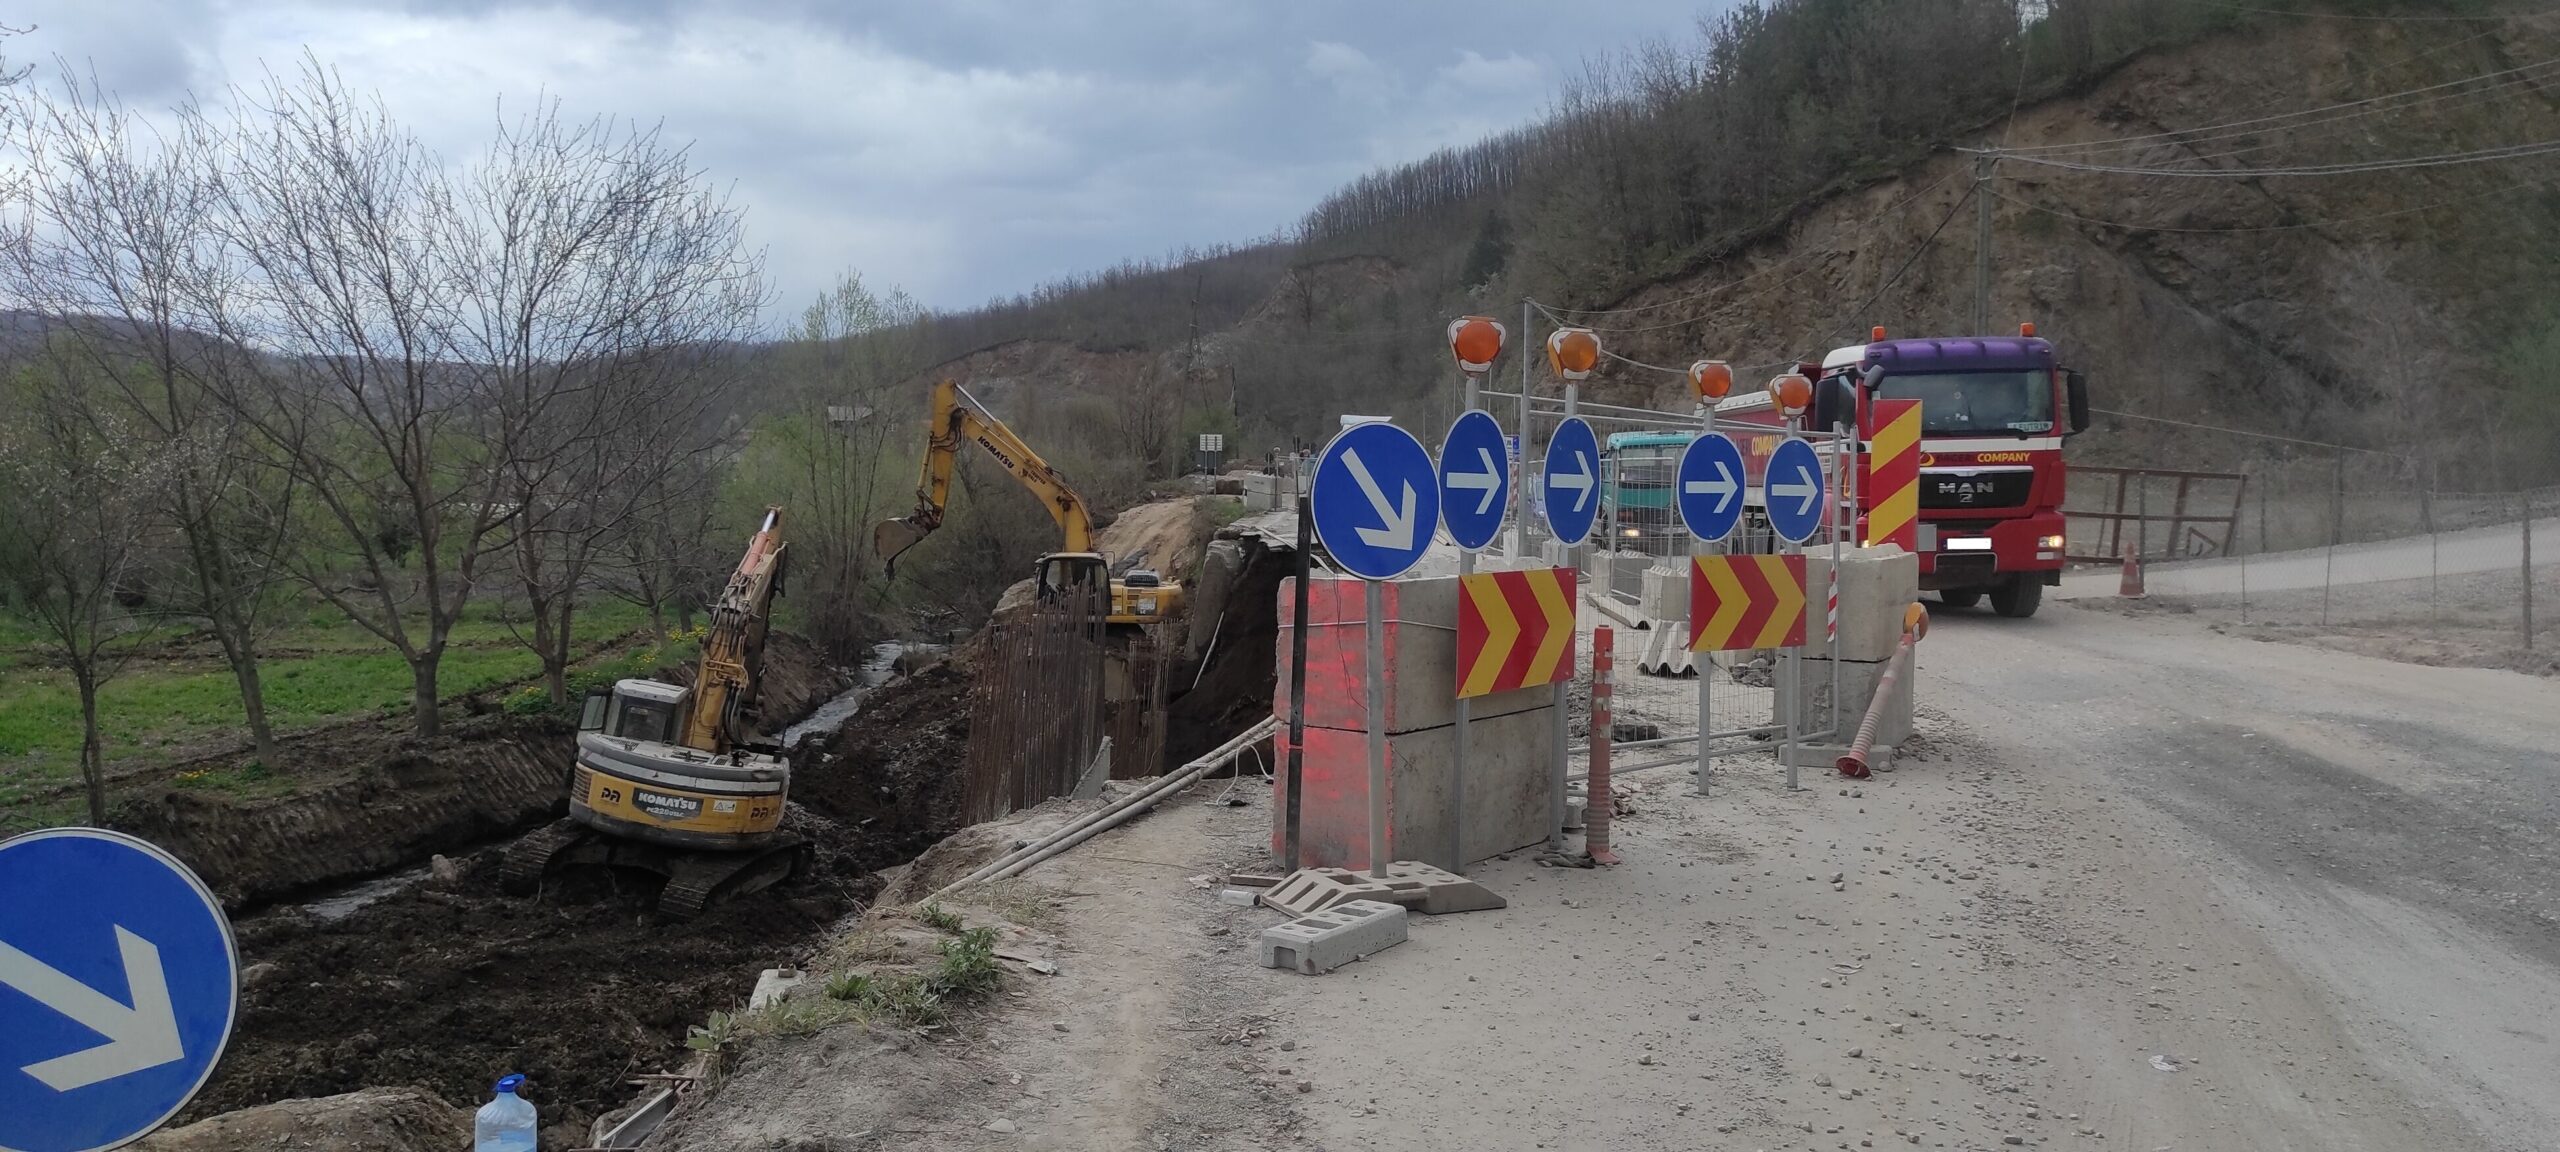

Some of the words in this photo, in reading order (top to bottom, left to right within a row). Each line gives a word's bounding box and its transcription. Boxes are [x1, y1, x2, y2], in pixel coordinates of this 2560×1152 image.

[977, 436, 1015, 469] KOMATSU
[1977, 452, 2031, 463] COMPANY
[1939, 482, 1994, 494] MAN
[638, 792, 698, 810] KOMATSU
